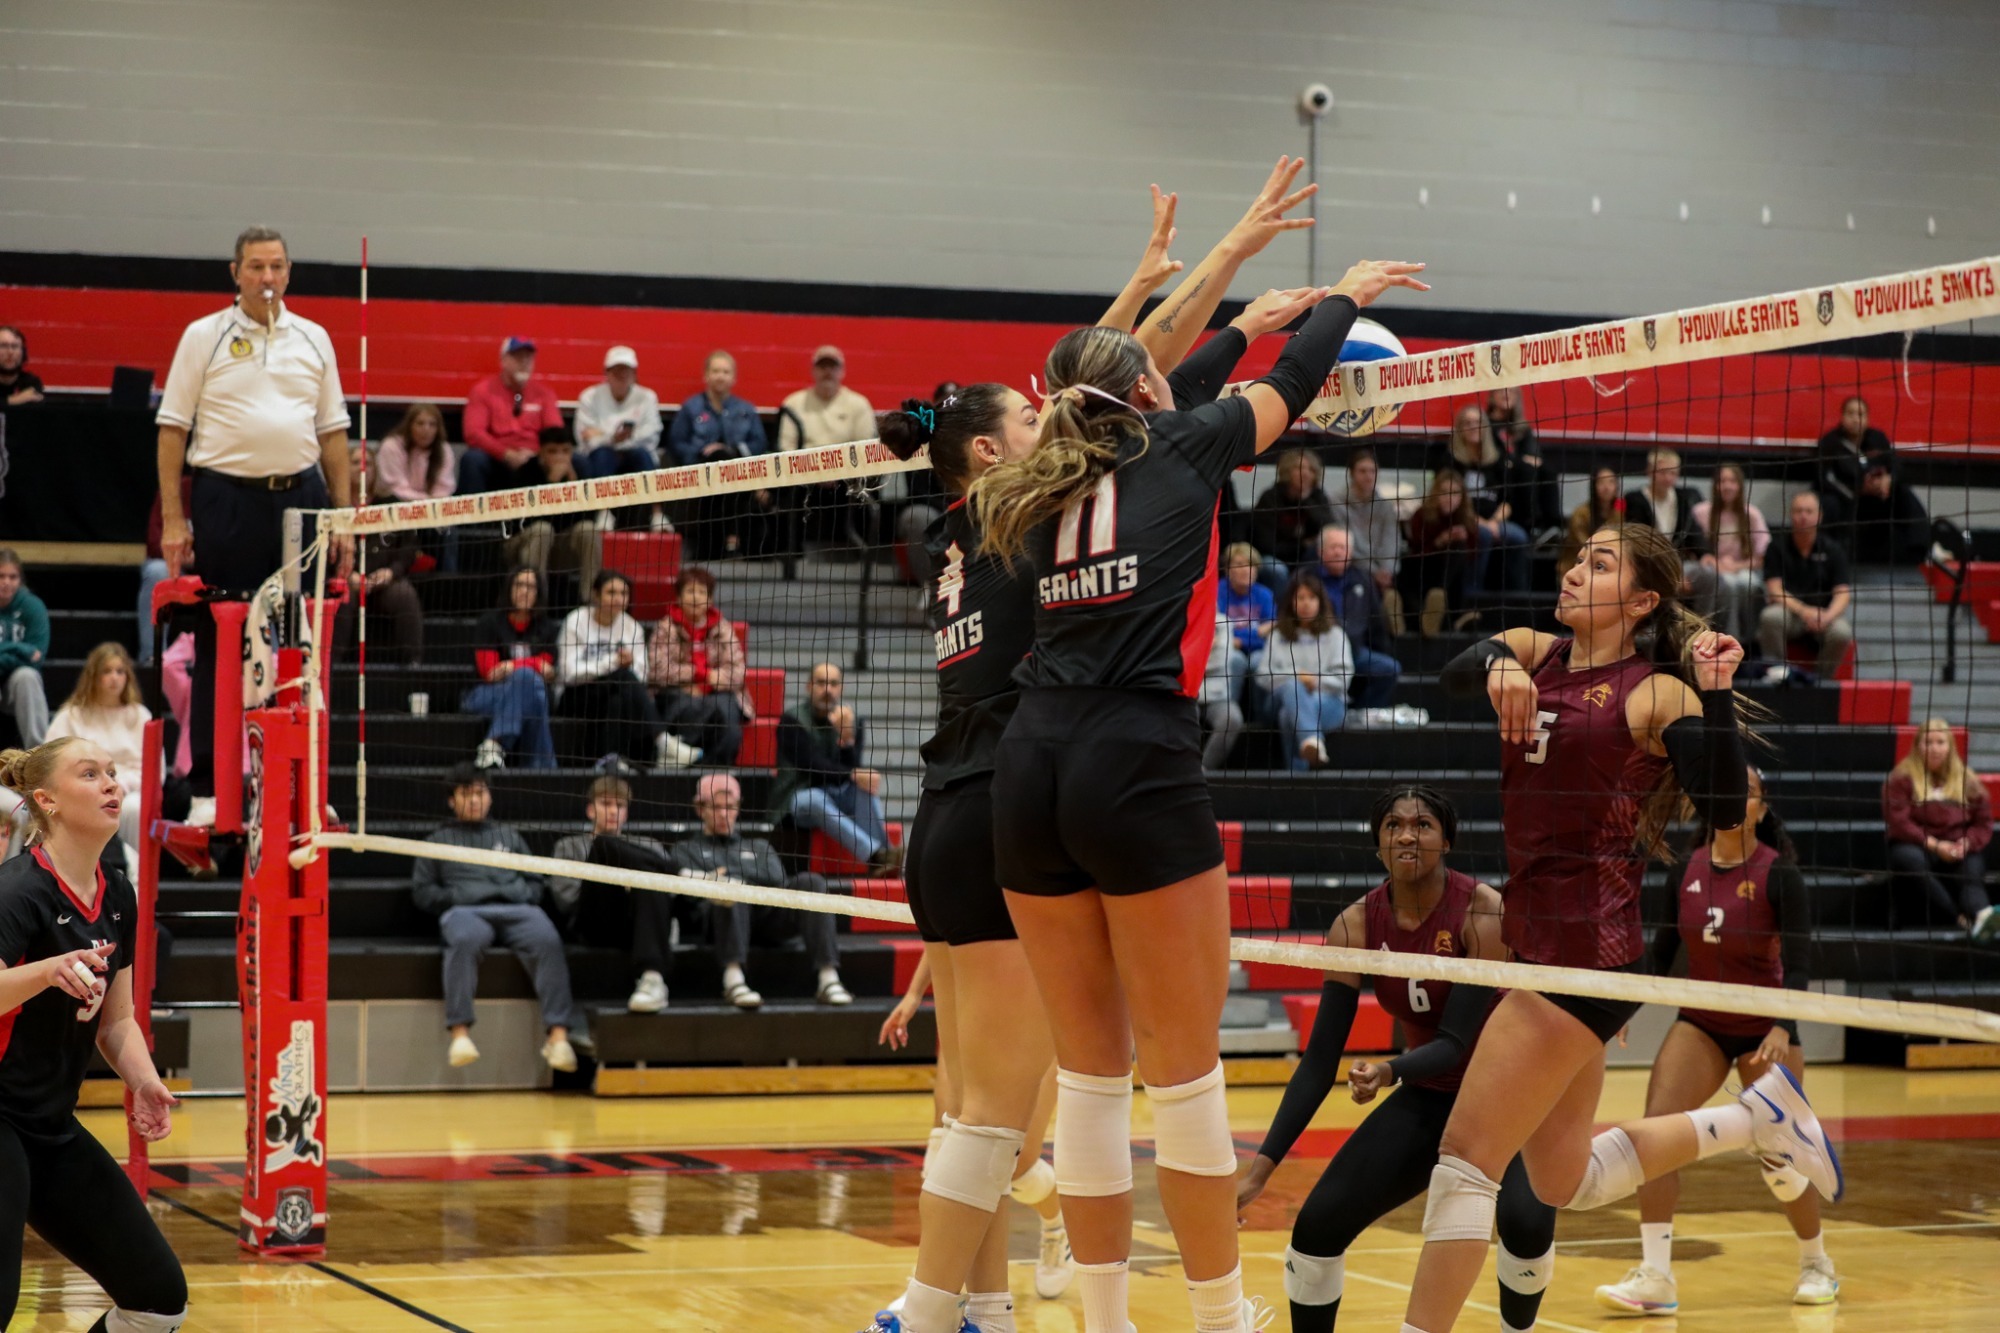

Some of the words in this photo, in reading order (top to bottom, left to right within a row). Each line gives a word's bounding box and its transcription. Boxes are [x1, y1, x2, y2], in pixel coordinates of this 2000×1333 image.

[1855, 277, 1933, 317] D'YOUVILLE
[1942, 266, 1994, 303] SAINTS
[1751, 299, 1799, 332] SAINTS
[1585, 326, 1626, 358] SAINTS
[1316, 373, 1341, 398] NTS
[1438, 352, 1475, 381] SAINTS
[937, 540, 966, 618] 4
[1039, 554, 1138, 604] SAINTS
[934, 610, 983, 662] AINTS
[1703, 907, 1725, 943] 2
[1408, 978, 1431, 1013] 6
